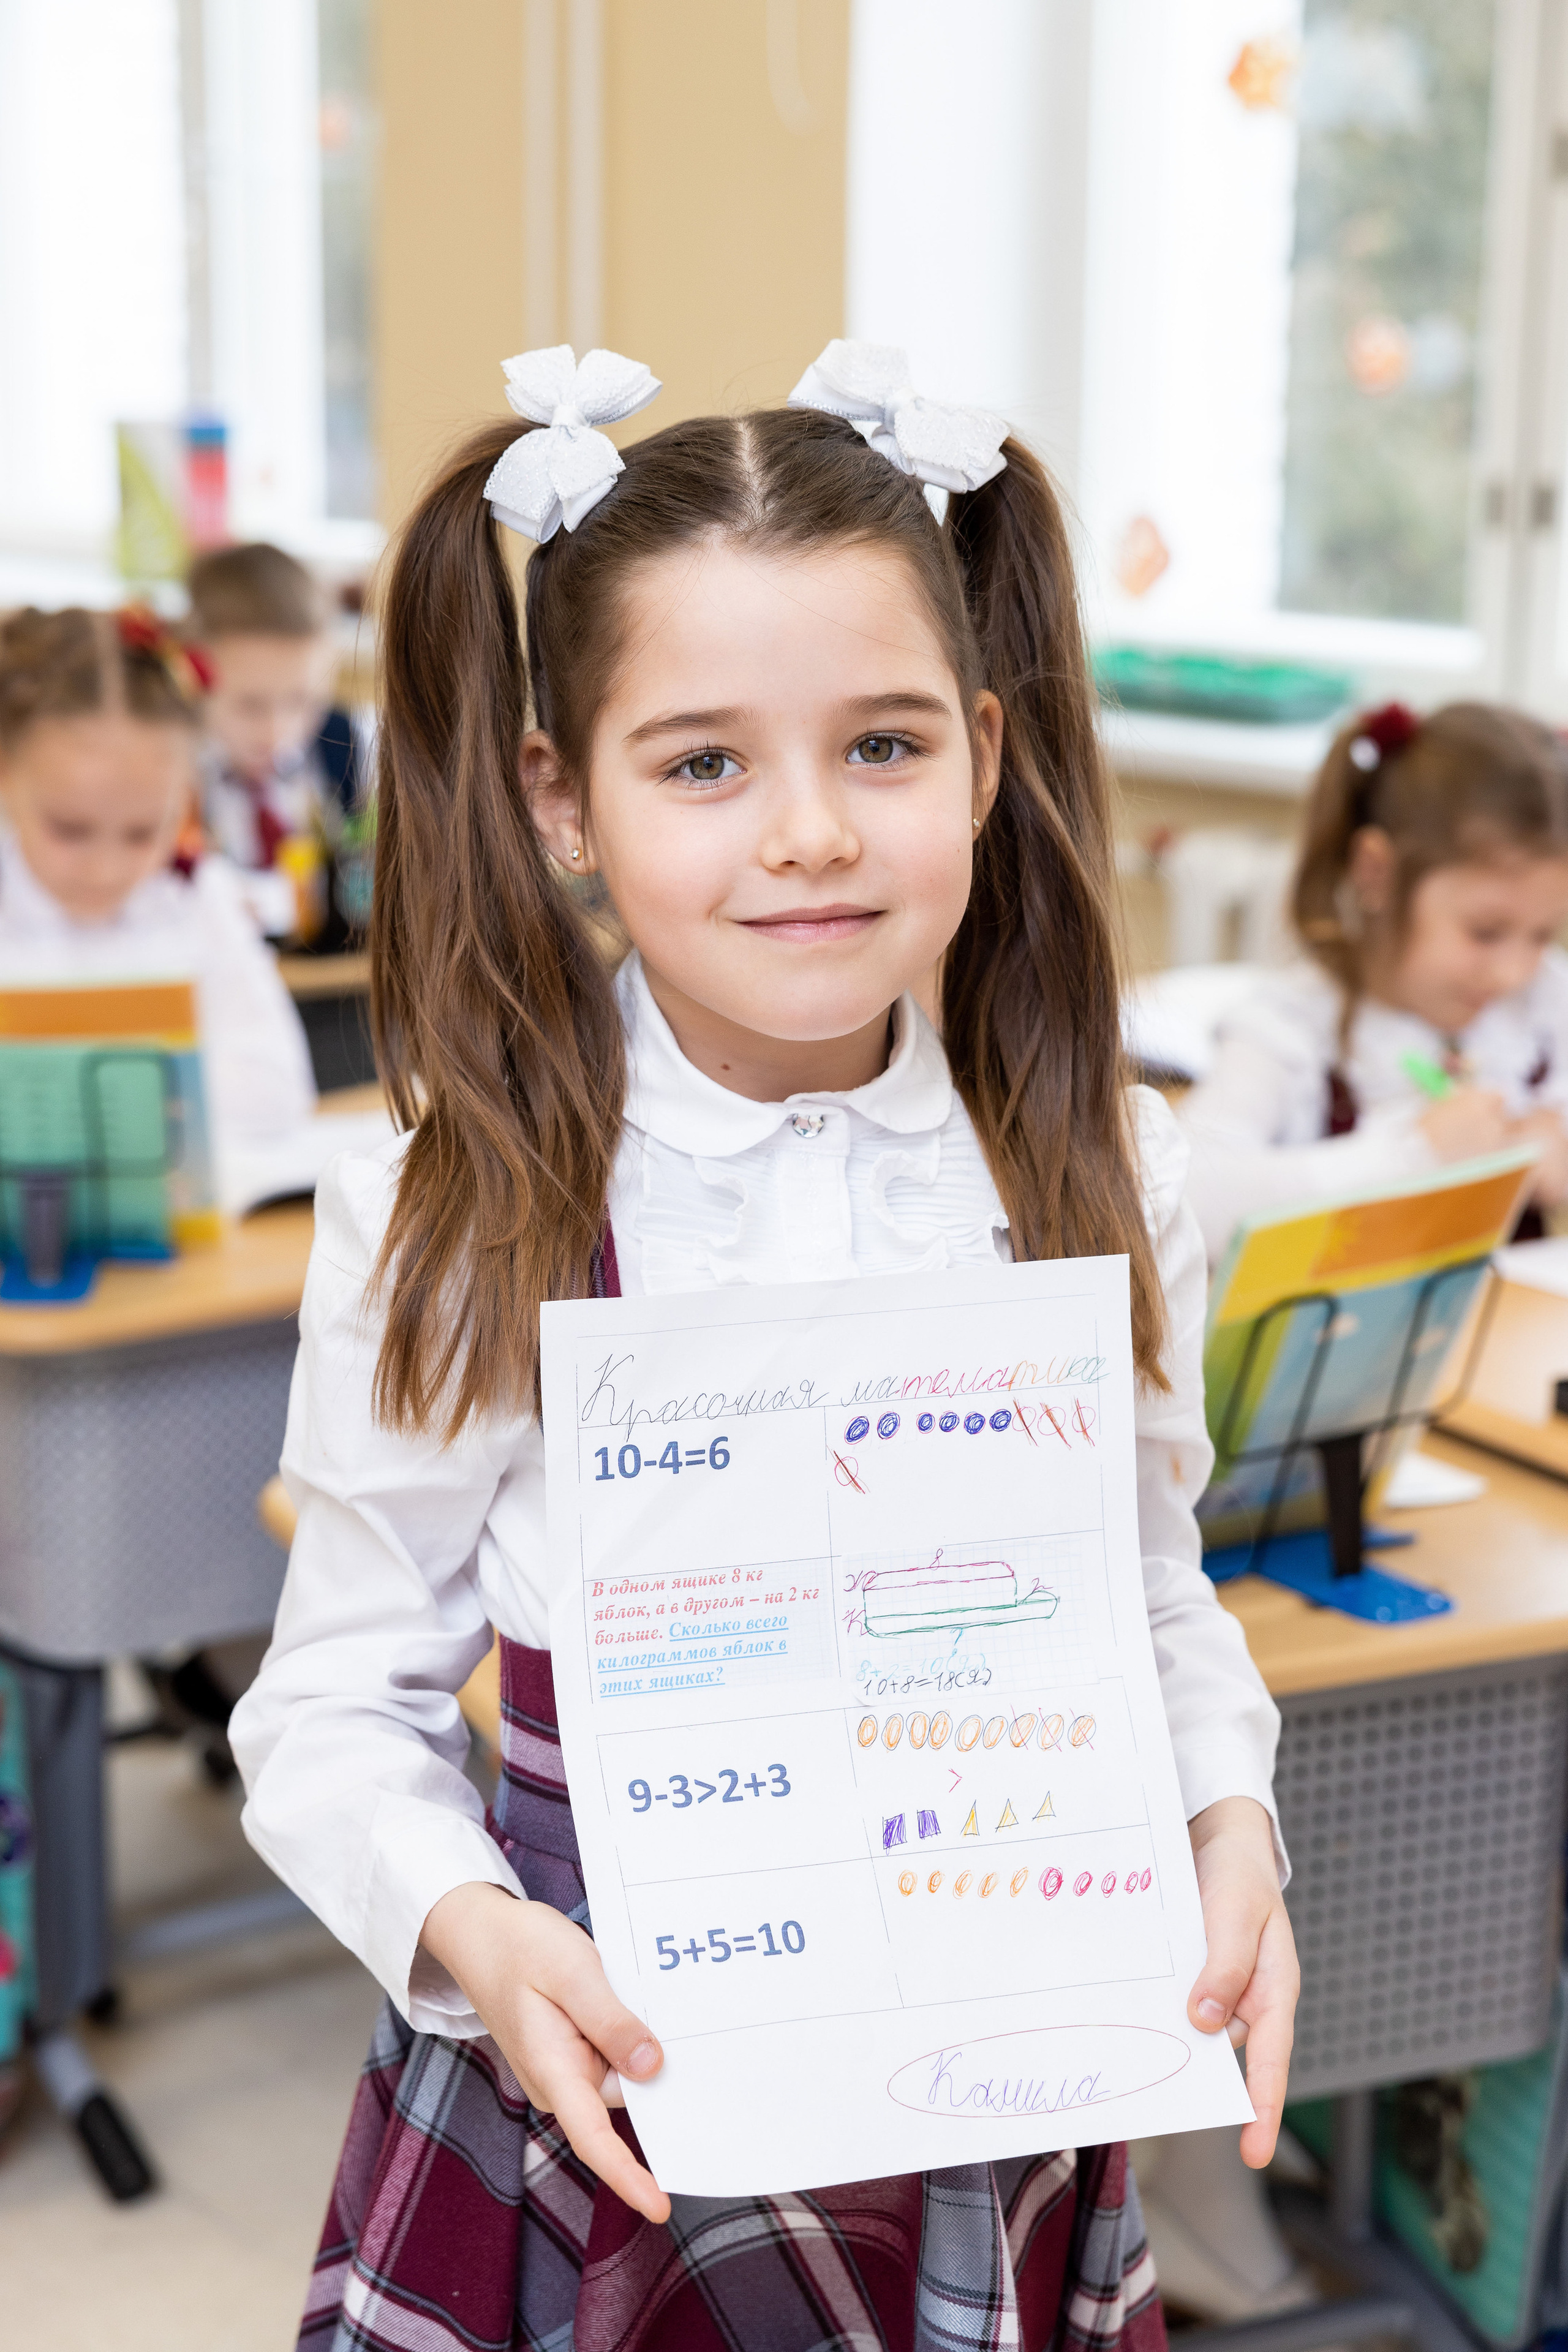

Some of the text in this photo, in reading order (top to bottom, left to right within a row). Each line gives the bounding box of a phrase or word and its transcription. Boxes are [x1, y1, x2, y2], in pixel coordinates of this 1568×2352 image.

[841, 1356, 1110, 1407] математика
[594, 1436, 730, 1481] 10-4=6
[592, 1568, 763, 1597] В одном ящике 8 кг
[594, 1604, 650, 1621] яблок,
[656, 1604, 665, 1615] а
[671, 1602, 678, 1613] в
[684, 1594, 744, 1616] другом
[764, 1592, 783, 1604] на
[789, 1587, 797, 1602] 2
[803, 1588, 819, 1600] кг
[595, 1615, 788, 1646] больше. Сколько всего
[597, 1639, 786, 1670] килограммов яблок в
[600, 1667, 723, 1694] этих ящиках?
[628, 1763, 791, 1813] 9-3>2+3
[655, 1920, 805, 1970] 5+5=10
